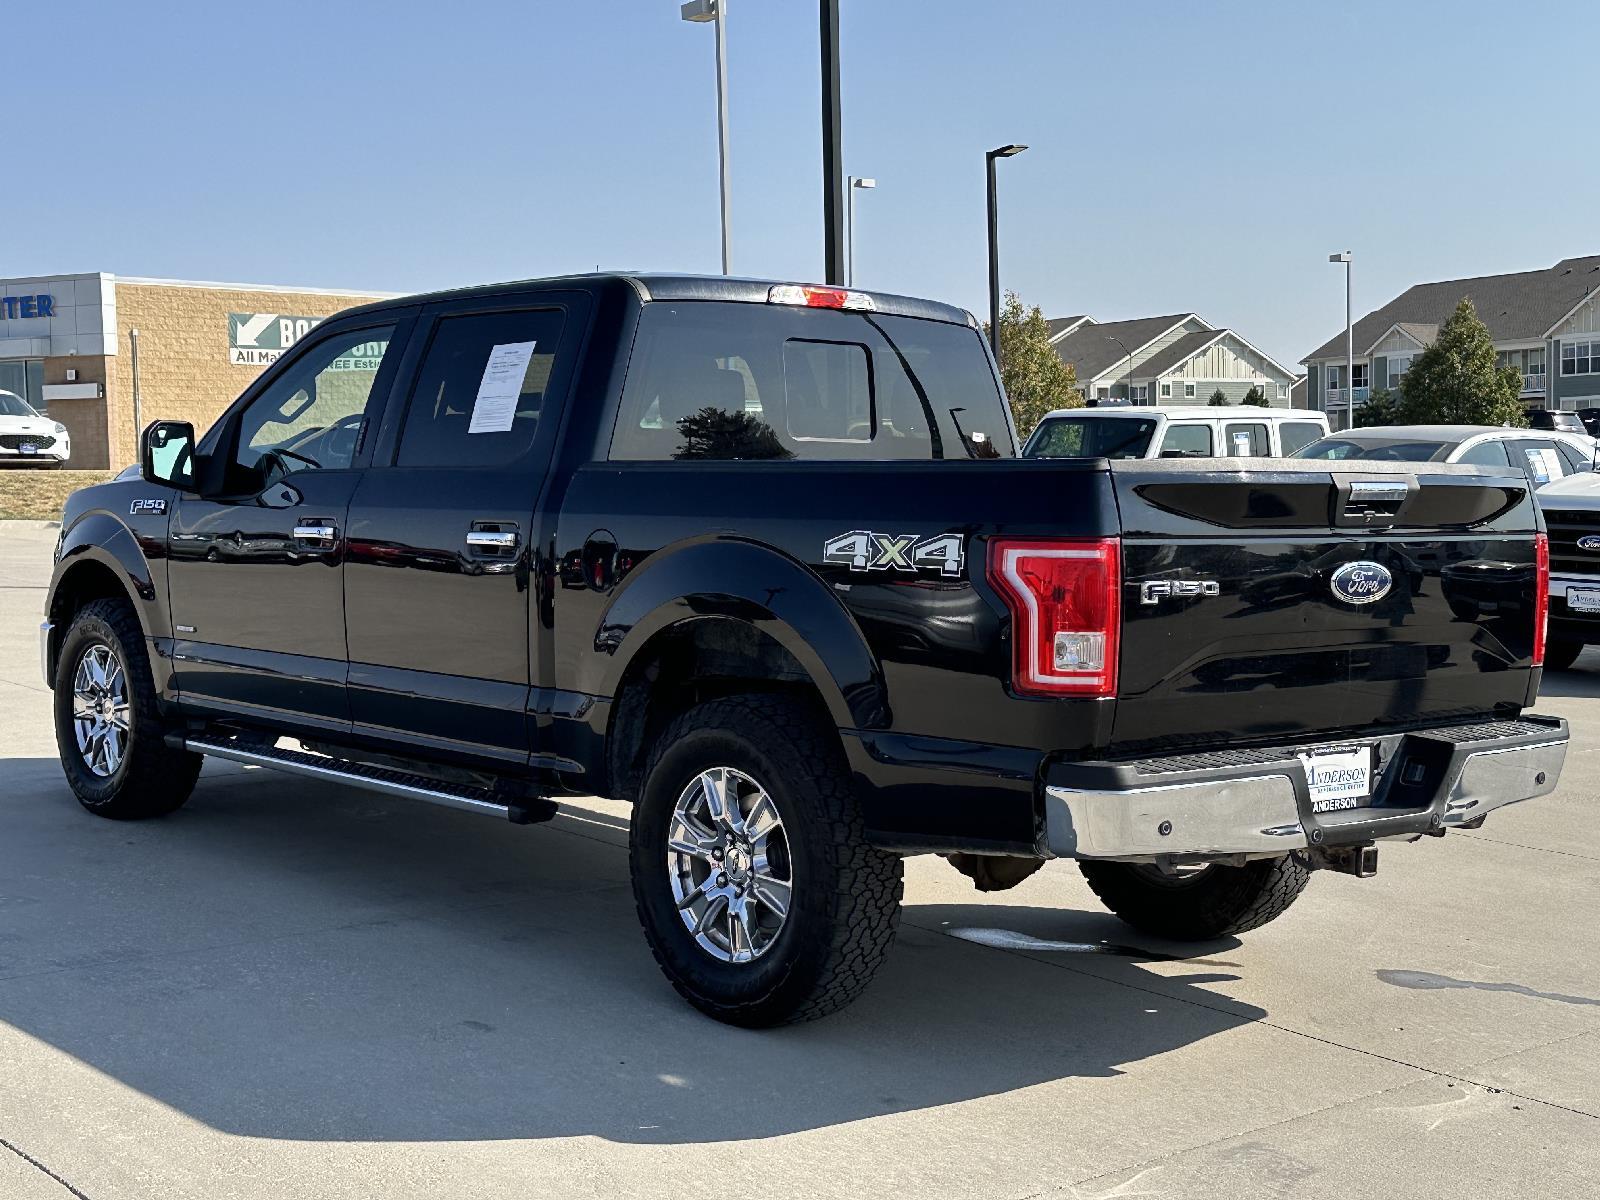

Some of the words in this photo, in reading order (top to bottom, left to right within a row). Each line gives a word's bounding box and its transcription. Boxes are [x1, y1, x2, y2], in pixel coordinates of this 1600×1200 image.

[236, 350, 254, 362] All
[259, 352, 281, 363] Ma
[354, 359, 380, 369] Esti
[1347, 570, 1380, 593] Ford
[1312, 797, 1357, 812] ANDERSON
